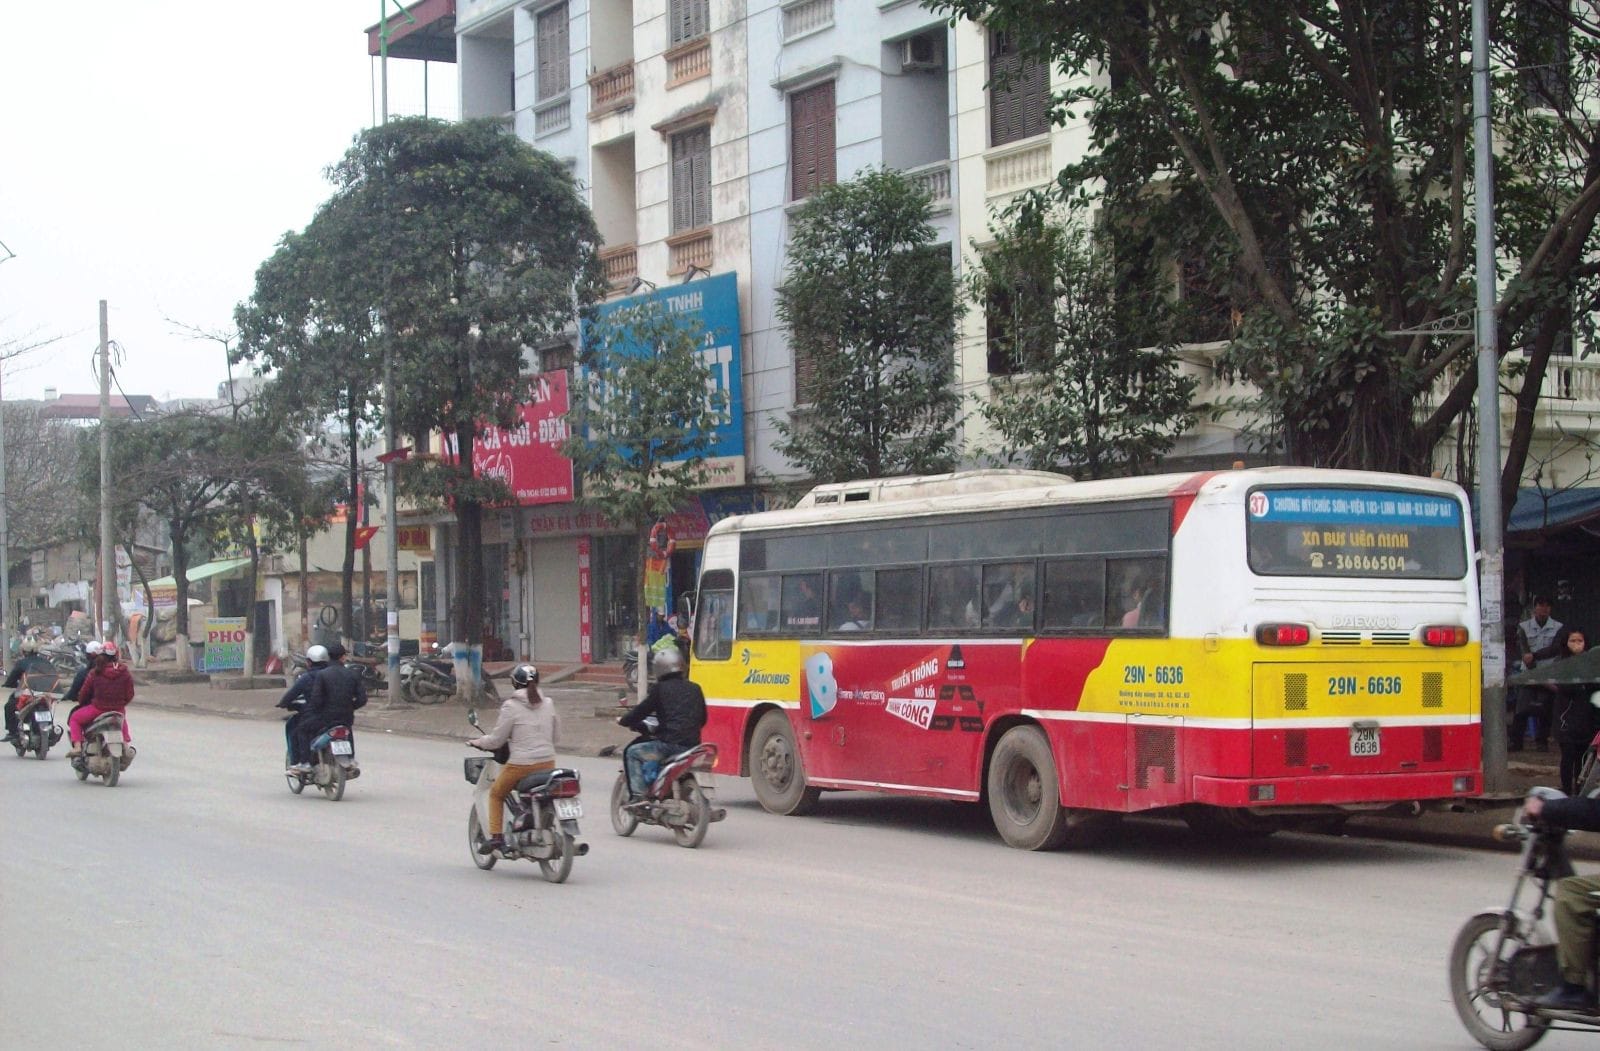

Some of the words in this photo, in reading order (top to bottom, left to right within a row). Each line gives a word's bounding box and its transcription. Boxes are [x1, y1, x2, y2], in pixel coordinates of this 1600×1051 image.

[667, 291, 703, 313] TNHH
[539, 410, 567, 449] ĐỆM
[1250, 495, 1266, 514] 37
[1324, 531, 1346, 546] BUS
[1336, 554, 1405, 571] 36866504
[1332, 615, 1399, 630] DAEWOO
[743, 668, 791, 685] HANOIBUS
[911, 657, 939, 683] THÔNG
[1124, 666, 1145, 684] 29N
[1155, 666, 1183, 684] 6636
[1328, 677, 1357, 695] 29N
[1368, 676, 1402, 695] 6636
[901, 700, 930, 727] CÔNG
[1357, 727, 1375, 741] 29N
[1354, 741, 1377, 753] 6636
